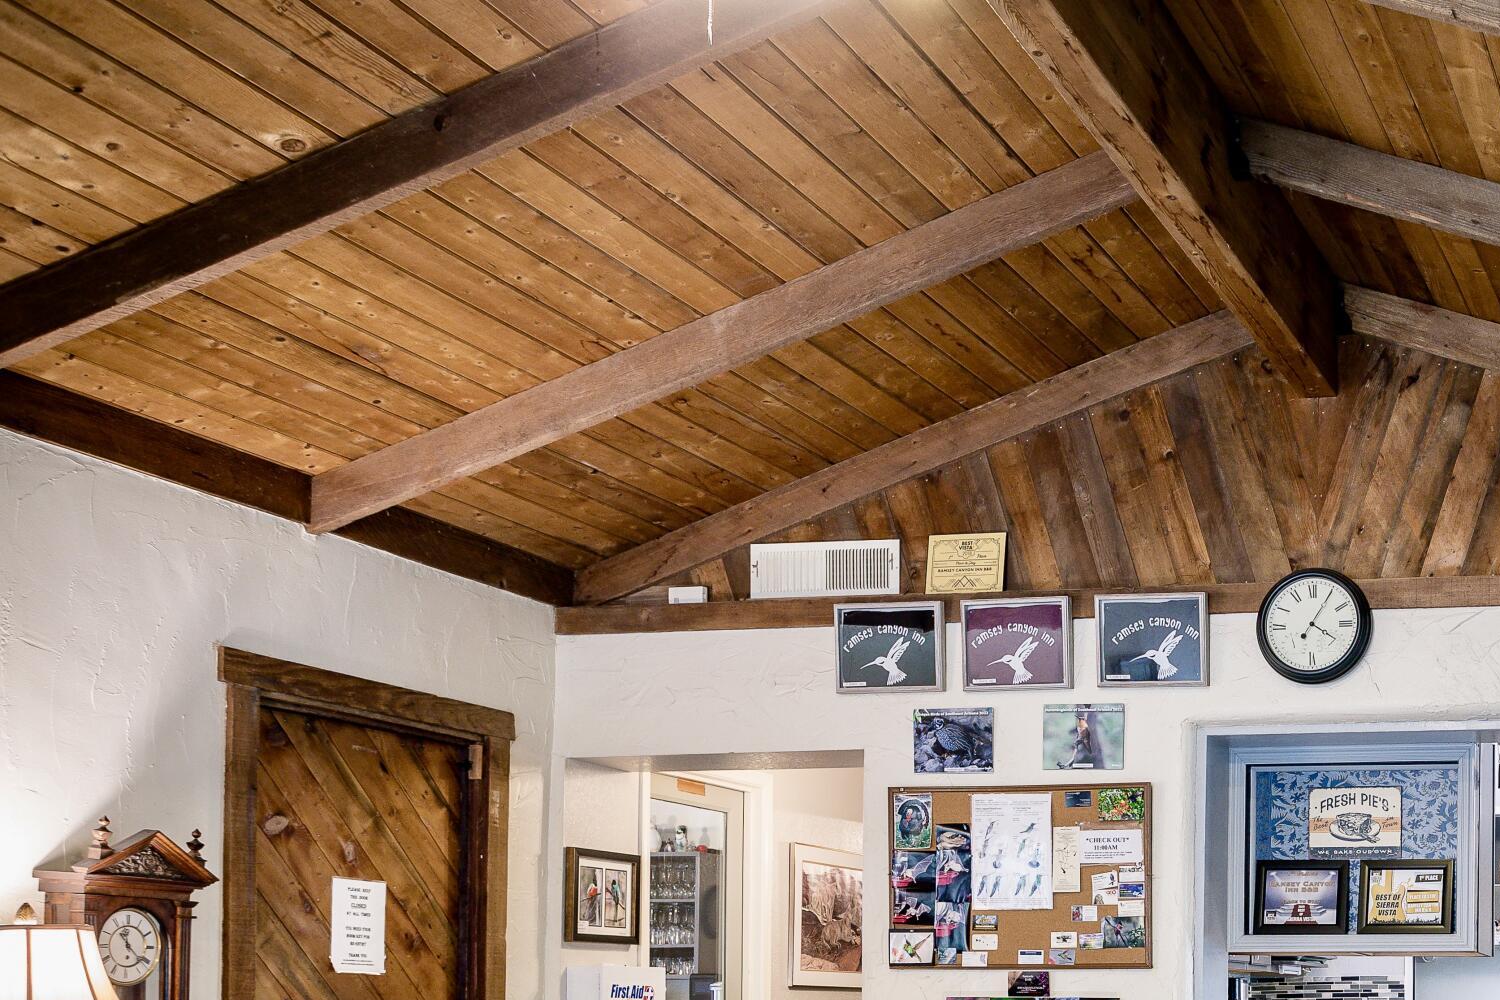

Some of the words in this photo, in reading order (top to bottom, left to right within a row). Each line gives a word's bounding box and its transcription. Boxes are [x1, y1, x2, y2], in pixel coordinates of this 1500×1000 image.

[842, 627, 873, 653] ramsey
[877, 624, 909, 637] canyon
[911, 630, 926, 646] inn
[971, 624, 1003, 649] ramsey
[1007, 622, 1039, 637] canyon
[1040, 631, 1056, 647] inn
[1111, 619, 1145, 646] ramsey
[1148, 617, 1182, 631] canyon
[1184, 624, 1200, 640] inn
[1320, 793, 1356, 813] FRESH
[1361, 793, 1389, 812] PIE'S
[1393, 893, 1402, 901] OF
[610, 984, 630, 999] First
[630, 985, 644, 999] Aid
